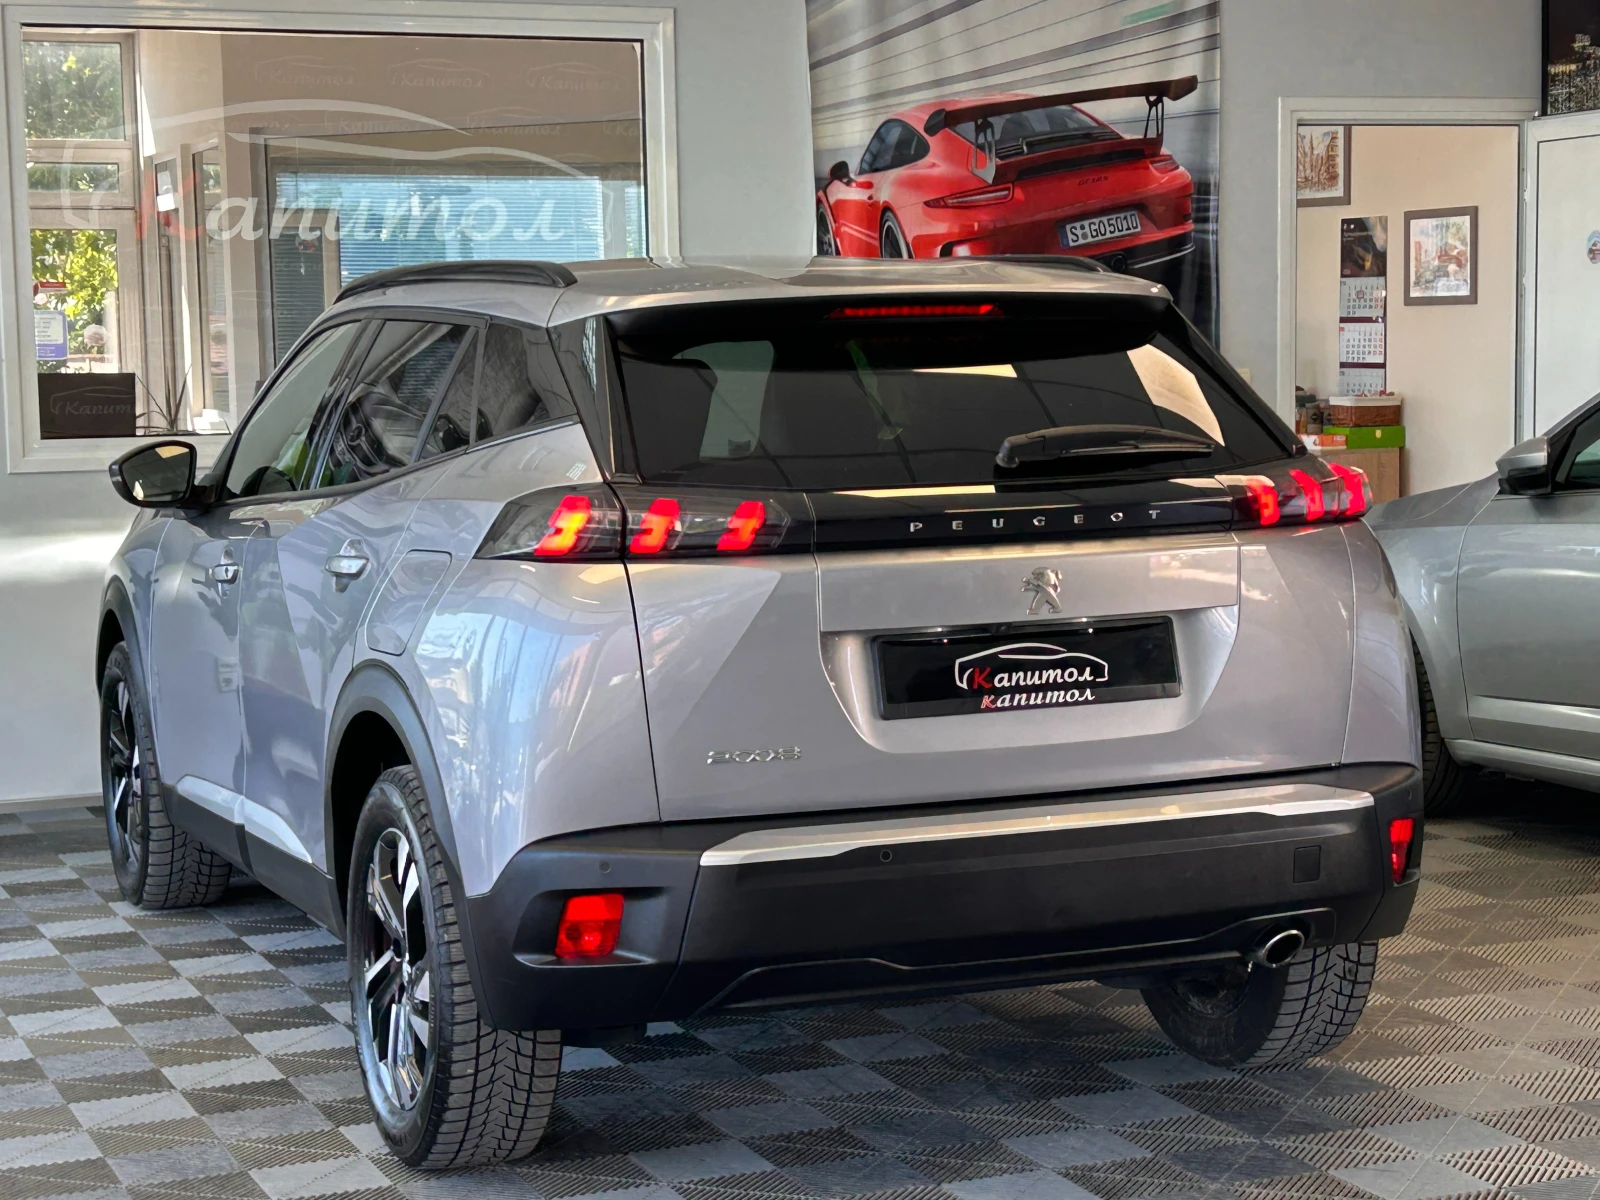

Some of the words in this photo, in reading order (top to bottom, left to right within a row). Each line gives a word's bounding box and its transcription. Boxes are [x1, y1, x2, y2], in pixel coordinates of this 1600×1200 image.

[64, 401, 135, 416] Капит
[909, 509, 1161, 533] PEUGEOT
[972, 666, 1094, 690] Капитол
[706, 746, 802, 765] 2008
